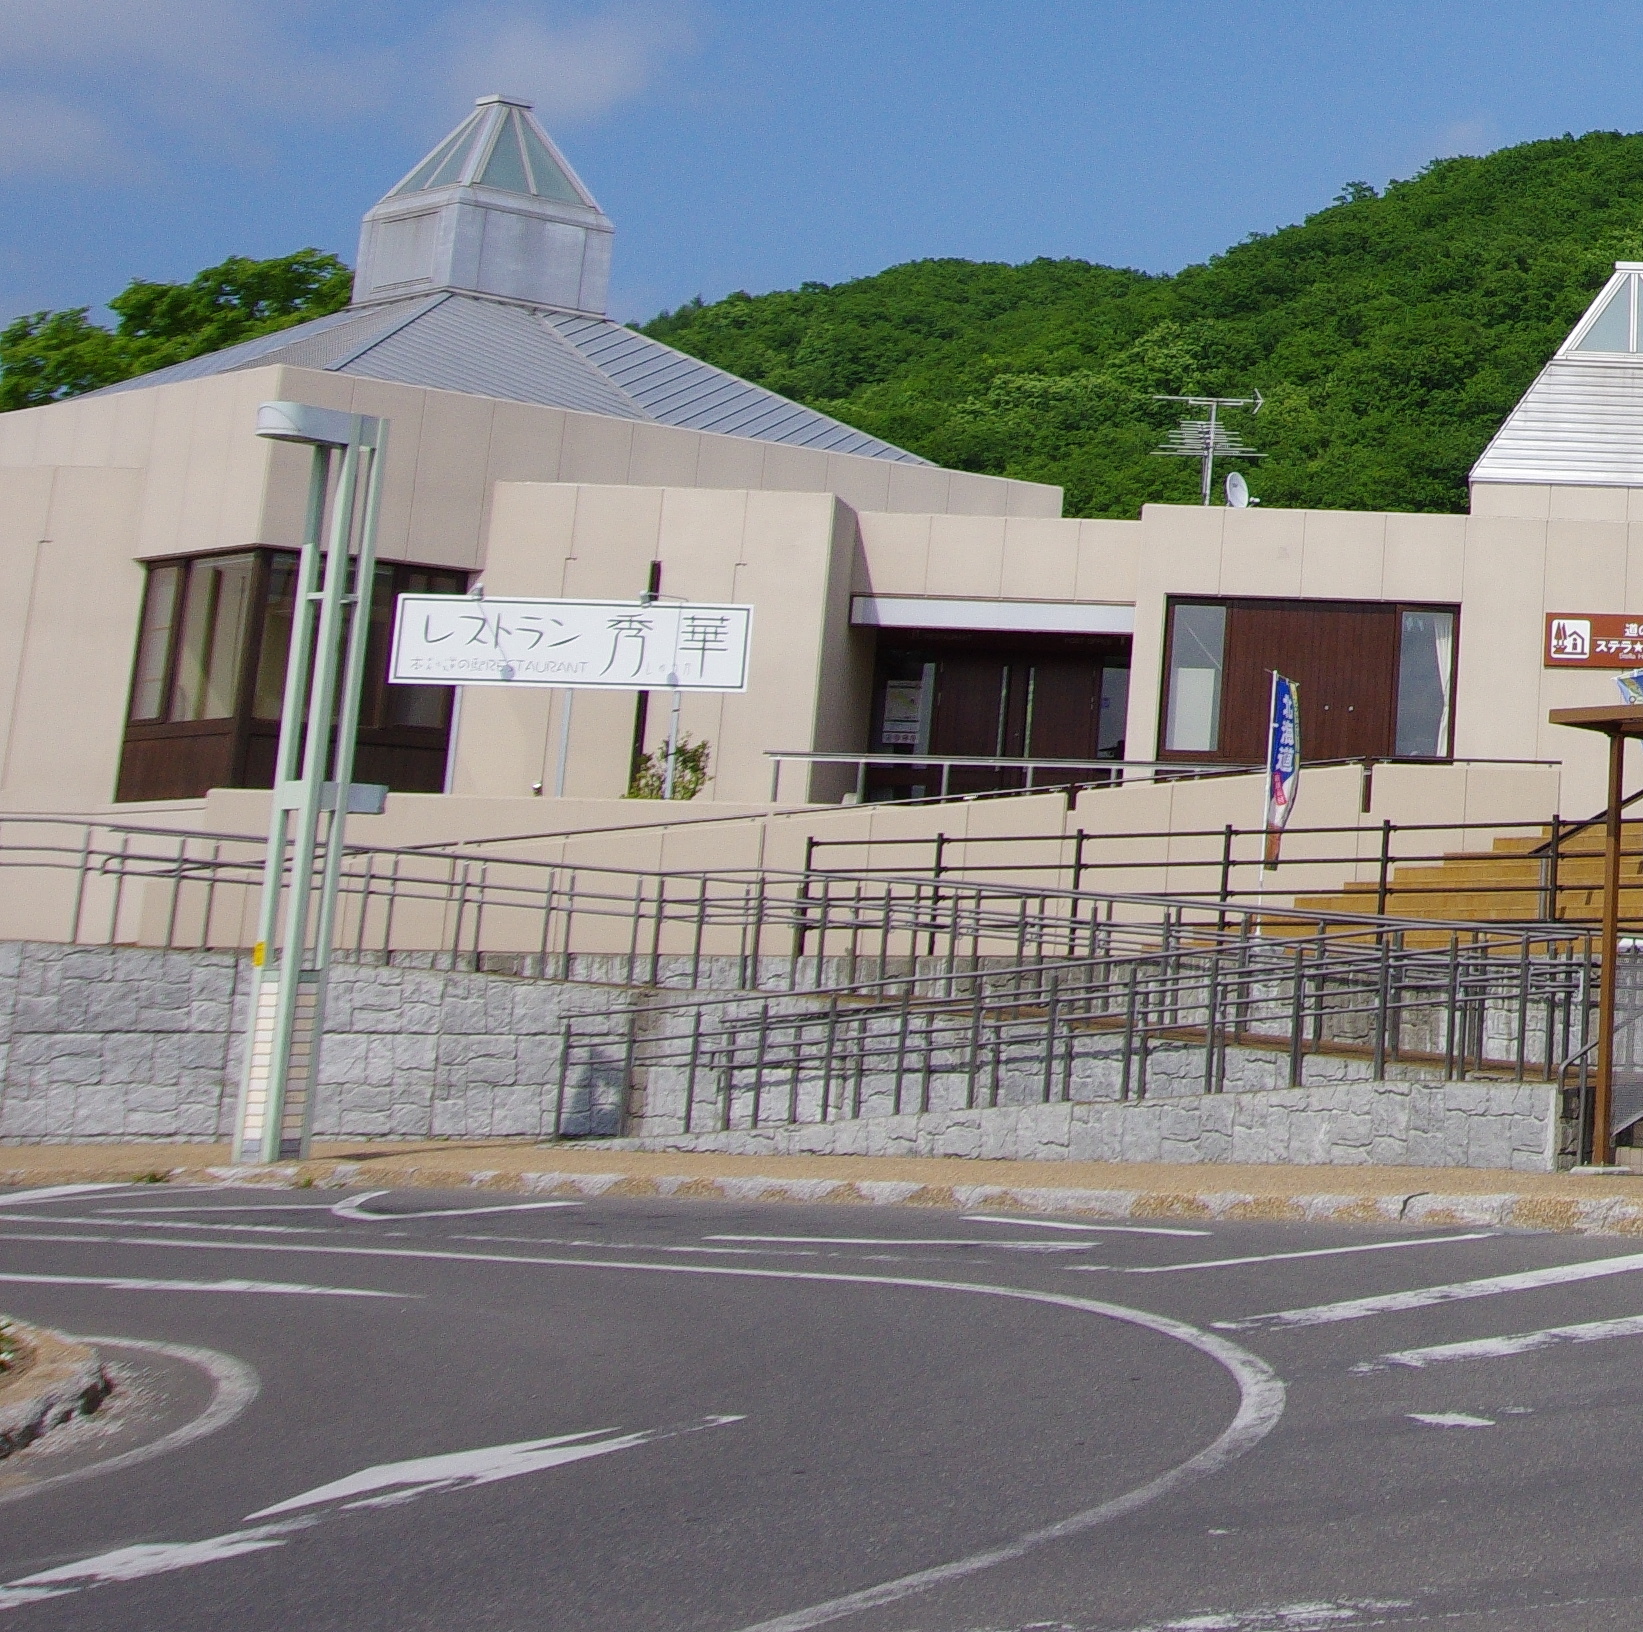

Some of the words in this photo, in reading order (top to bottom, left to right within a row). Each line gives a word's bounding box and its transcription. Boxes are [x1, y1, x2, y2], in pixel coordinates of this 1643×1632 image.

[425, 613, 582, 650] レストラン
[600, 613, 731, 678] 秀華
